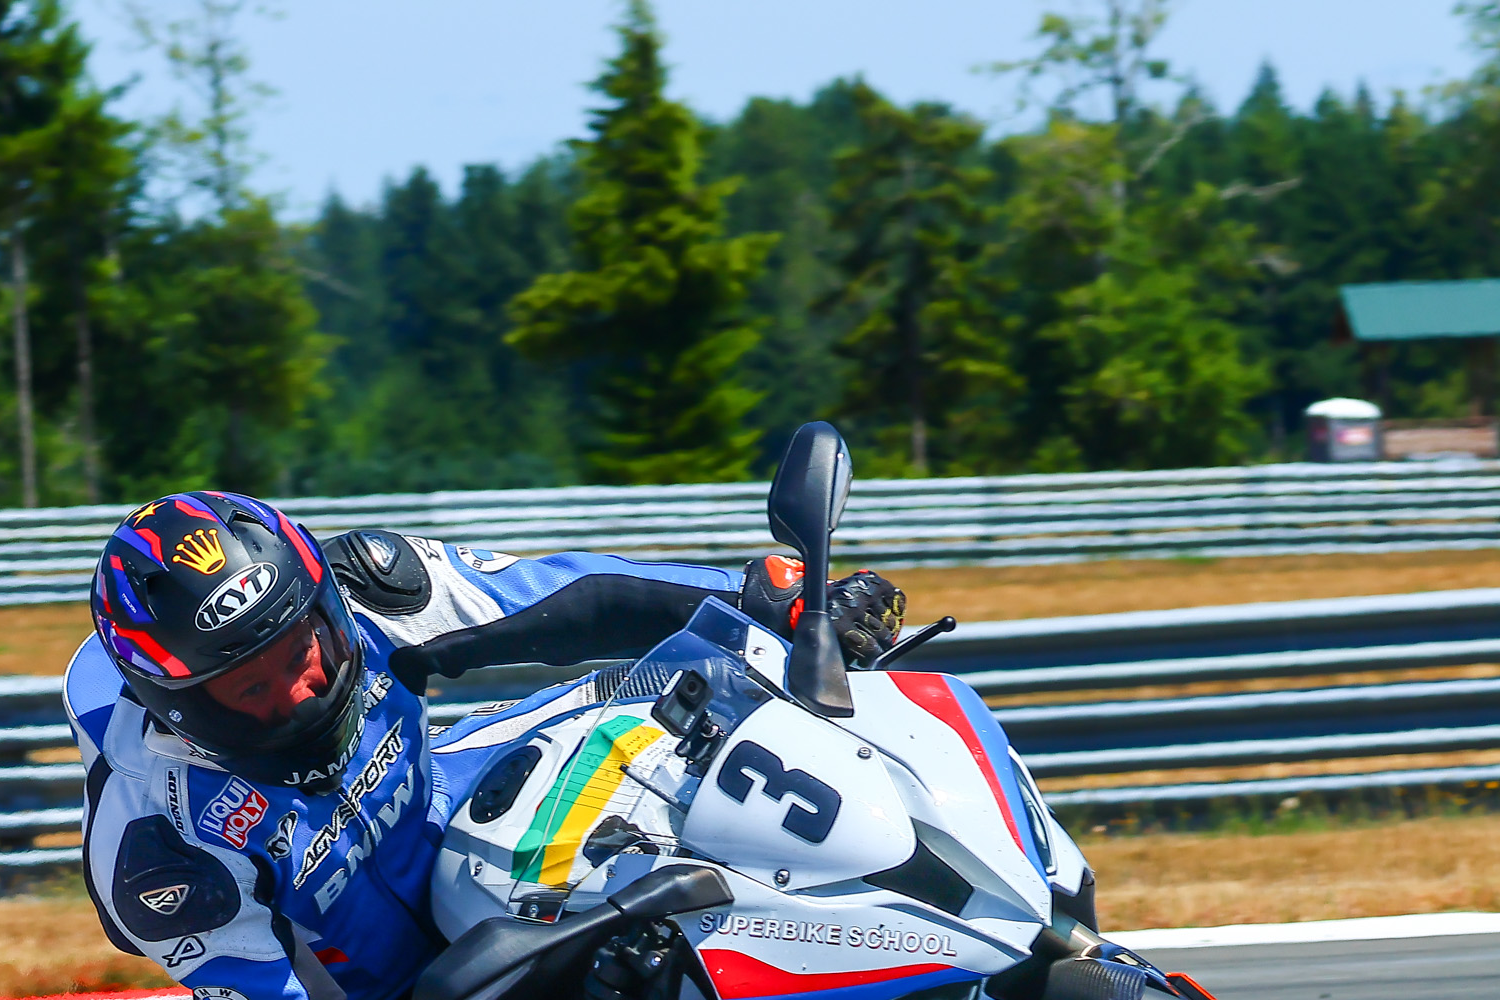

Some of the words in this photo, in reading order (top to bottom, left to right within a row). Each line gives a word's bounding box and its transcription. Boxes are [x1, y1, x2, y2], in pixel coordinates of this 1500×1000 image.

[198, 566, 263, 628] KYT
[362, 672, 394, 714] MES
[283, 714, 365, 785] JAMES
[203, 780, 249, 832] LIQUI
[225, 793, 264, 844] MOLY
[717, 740, 841, 843] 3
[314, 763, 414, 914] BMW
[700, 912, 842, 946] SUPERBIKE
[847, 927, 957, 957] SCHOOL
